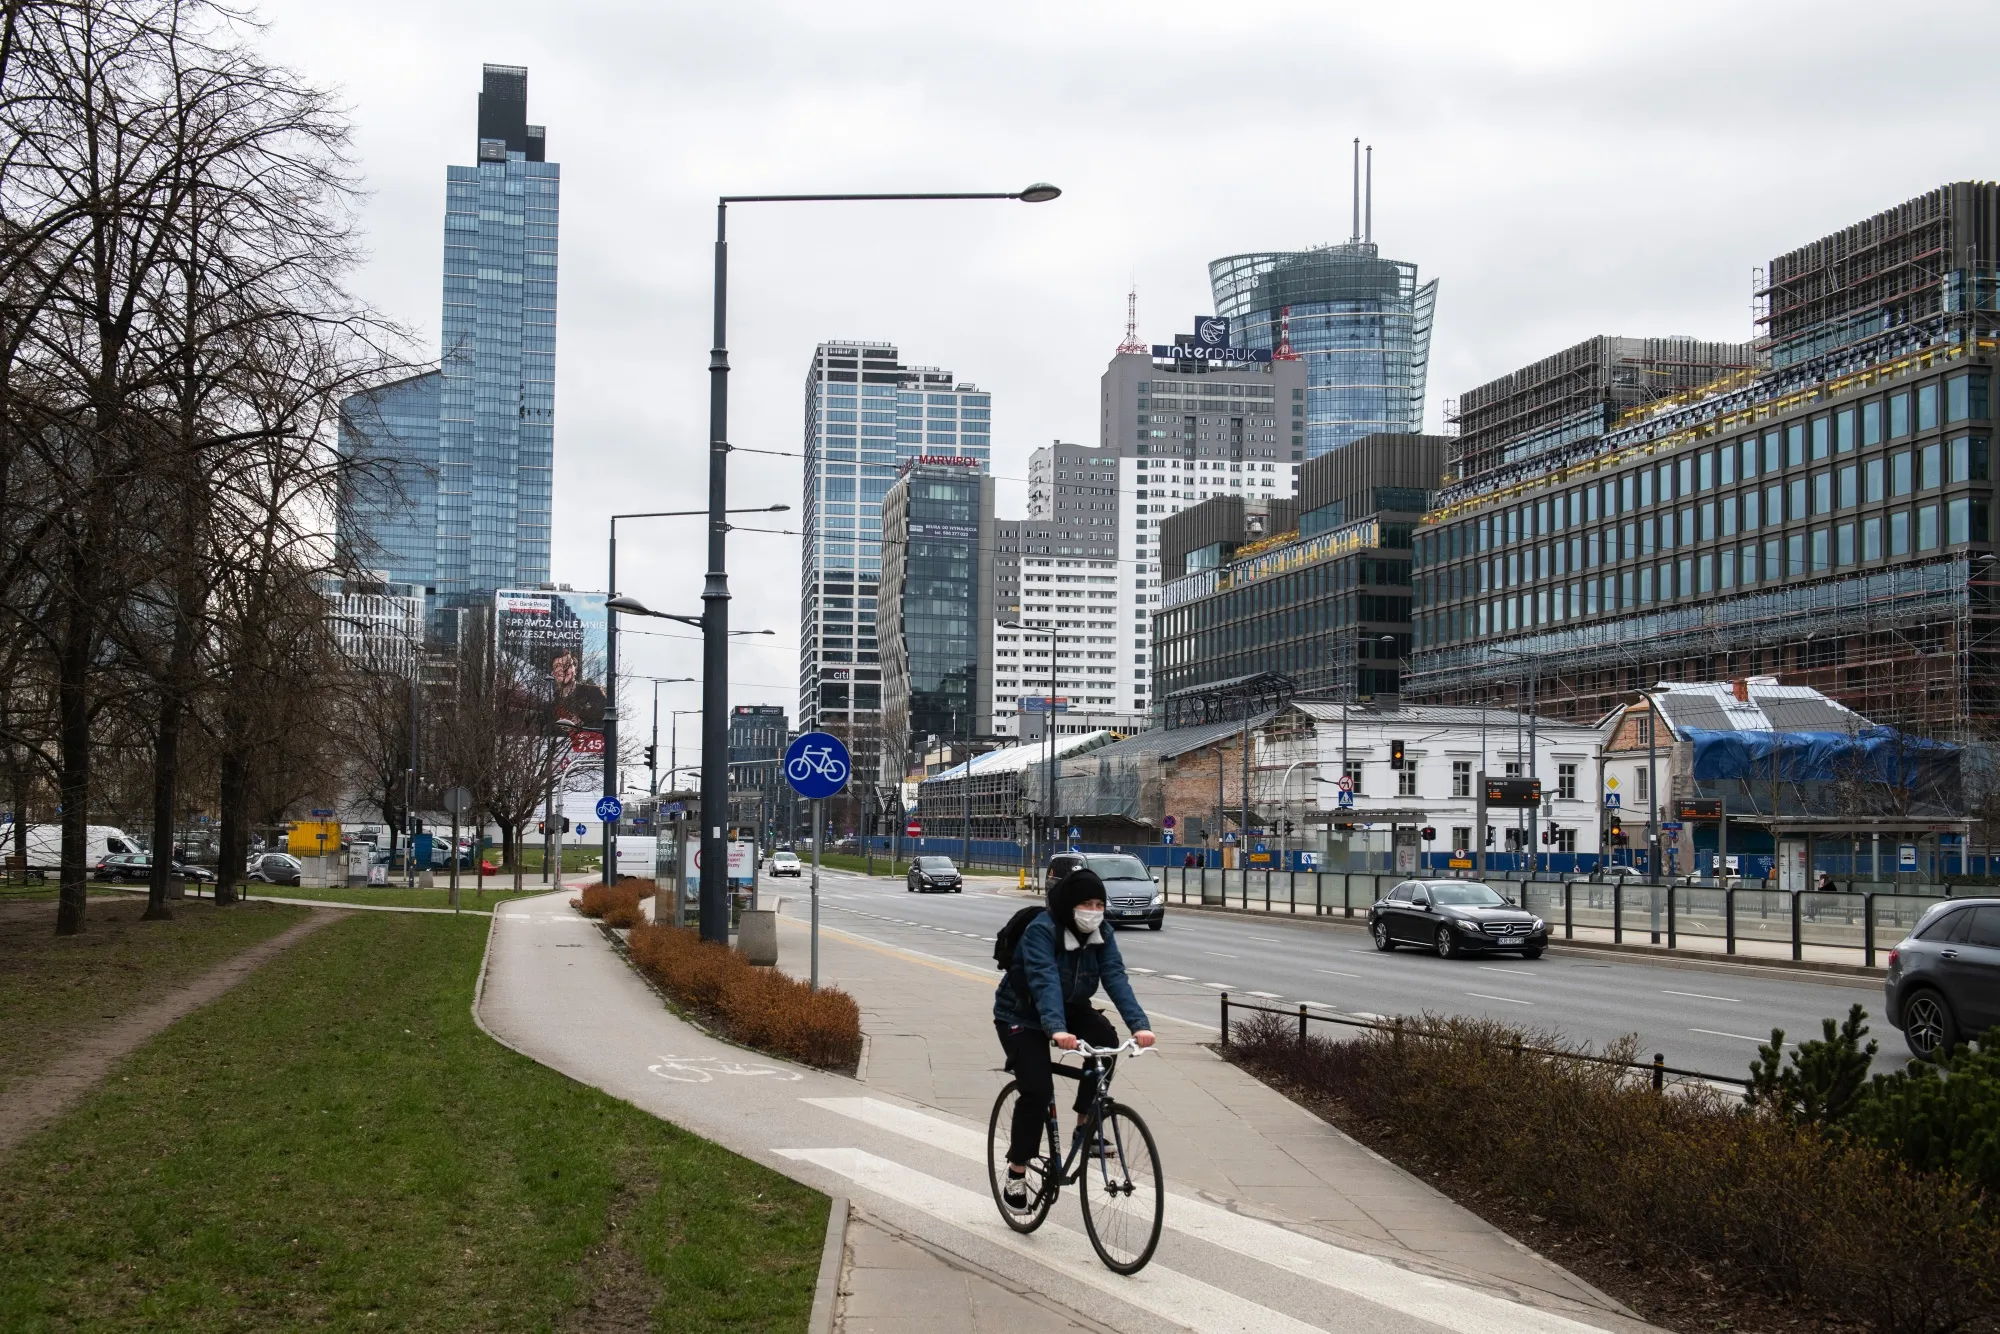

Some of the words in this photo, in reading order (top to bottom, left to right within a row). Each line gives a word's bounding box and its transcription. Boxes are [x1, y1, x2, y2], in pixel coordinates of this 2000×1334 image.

[919, 455, 979, 467] MARVIPOL
[555, 620, 563, 628] O
[565, 620, 578, 629] ILE
[580, 620, 607, 632] MNIEJ
[505, 629, 545, 639] MOŻESZ
[833, 670, 849, 680] citi
